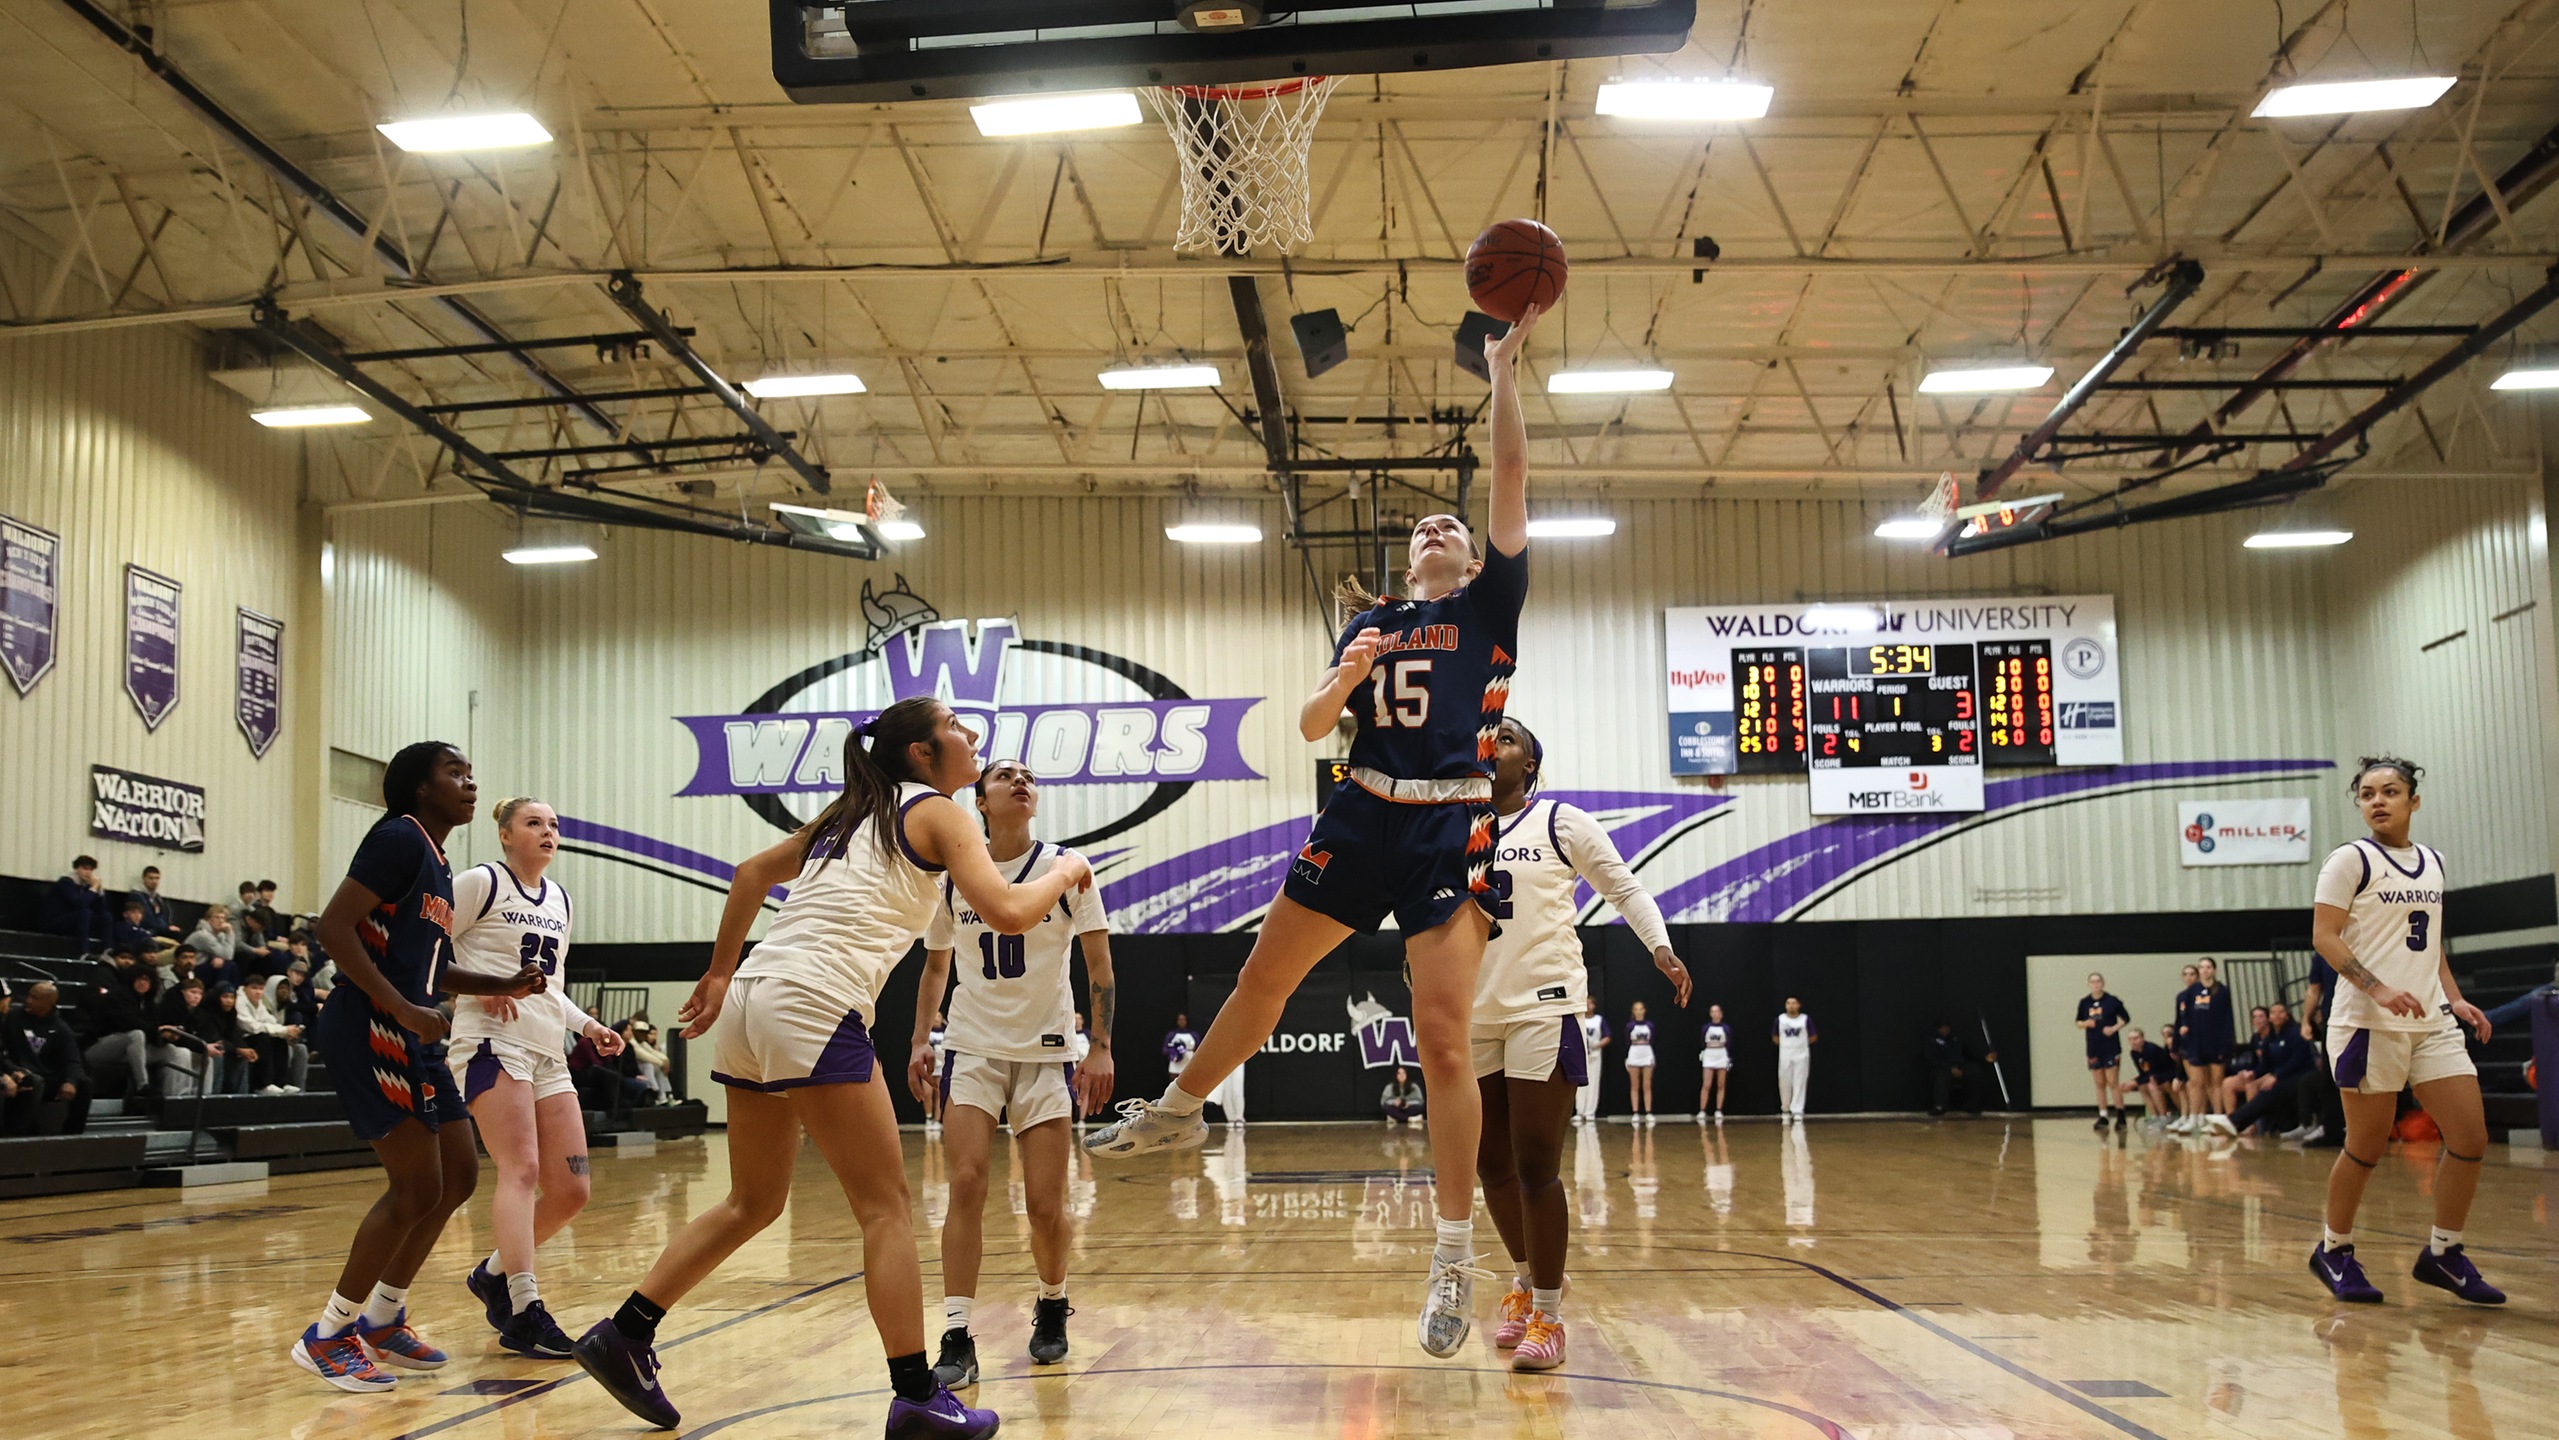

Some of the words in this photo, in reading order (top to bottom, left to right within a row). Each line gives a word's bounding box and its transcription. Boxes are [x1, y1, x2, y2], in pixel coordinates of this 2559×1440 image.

[1914, 604, 2076, 632] UNIVERSITY
[1375, 624, 1459, 657] DLAND
[1869, 645, 1931, 674] 5:34
[1998, 660, 2006, 675] 1
[2010, 658, 2022, 675] 0
[2037, 658, 2049, 675] 0
[1749, 666, 1759, 683] 3
[1763, 665, 1775, 683] 0
[1790, 664, 1802, 682] 0
[1928, 675, 1969, 690] GUEST
[1743, 683, 1760, 700] 10
[1769, 684, 1777, 698] 1
[1791, 682, 1802, 699] 2
[1811, 678, 1874, 694] WARRIORS
[1876, 684, 1908, 695] PERIOD
[1995, 676, 2006, 692] 3
[2011, 676, 2022, 693] 0
[2038, 675, 2049, 692] 0
[1370, 659, 1434, 728] 15
[1990, 693, 2007, 711] 12
[2011, 693, 2023, 710] 0
[2038, 692, 2050, 709] 0
[1743, 700, 1761, 718] 12
[1770, 702, 1777, 716] 1
[1791, 700, 1803, 716] 2
[1893, 696, 1901, 717] 1
[1956, 691, 1973, 719] 3
[1739, 718, 1762, 735] 21
[1766, 717, 1778, 735] 0
[1792, 717, 1804, 732] 4
[1864, 722, 1897, 733] PLAYER
[1900, 721, 1922, 732] FOUL
[1948, 720, 1976, 731] FOULS
[1990, 712, 2008, 727] 14
[2012, 710, 2024, 727] 0
[2041, 710, 2052, 726] 3
[1813, 724, 1840, 734] FOULS
[1991, 729, 2009, 746] 15
[2013, 728, 2025, 746] 0
[2040, 727, 2052, 746] 0
[724, 705, 1211, 787] WAIORS
[1740, 735, 1762, 753] 25
[1766, 735, 1779, 752] 0
[1794, 735, 1805, 752] 3
[1823, 734, 1837, 755] 2
[1847, 738, 1860, 752] 4
[1931, 735, 1942, 752] 3
[1959, 730, 1973, 751] 2
[1813, 757, 1841, 768] SCORE
[1881, 756, 1911, 766] MATCH
[1948, 755, 1976, 765] SCORE
[93, 772, 204, 819] WARRIOR
[92, 800, 181, 841] NATION
[2219, 825, 2305, 841] MILLER
[1496, 848, 1542, 862] IORS
[501, 912, 566, 934] WARRIOR
[2406, 910, 2430, 952] 3
[520, 932, 559, 976] 25
[979, 932, 1026, 980] 10
[426, 937, 443, 996] 1
[1259, 1033, 1345, 1053] LDORF
